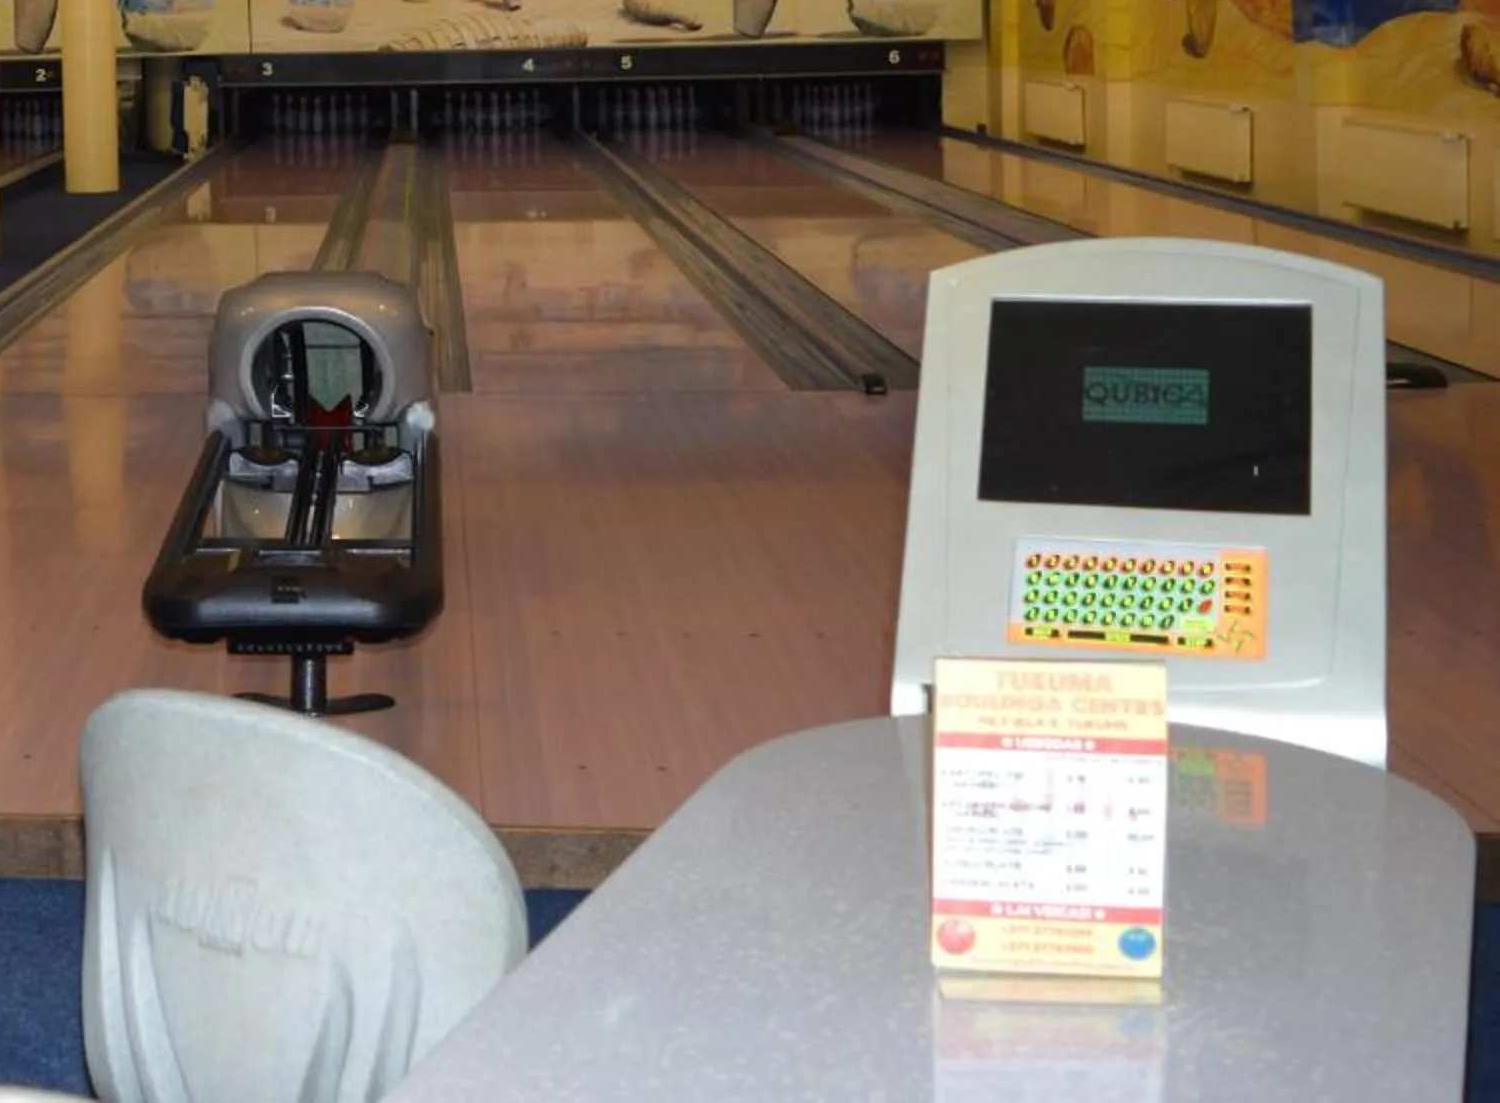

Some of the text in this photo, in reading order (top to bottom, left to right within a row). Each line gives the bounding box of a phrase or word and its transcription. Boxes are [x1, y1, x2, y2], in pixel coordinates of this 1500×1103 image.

[521, 57, 535, 72] 4
[620, 55, 633, 71] 5
[888, 49, 901, 65] 6
[35, 67, 47, 82] 2
[261, 61, 274, 77] 3
[997, 671, 1114, 693] TUKUMA
